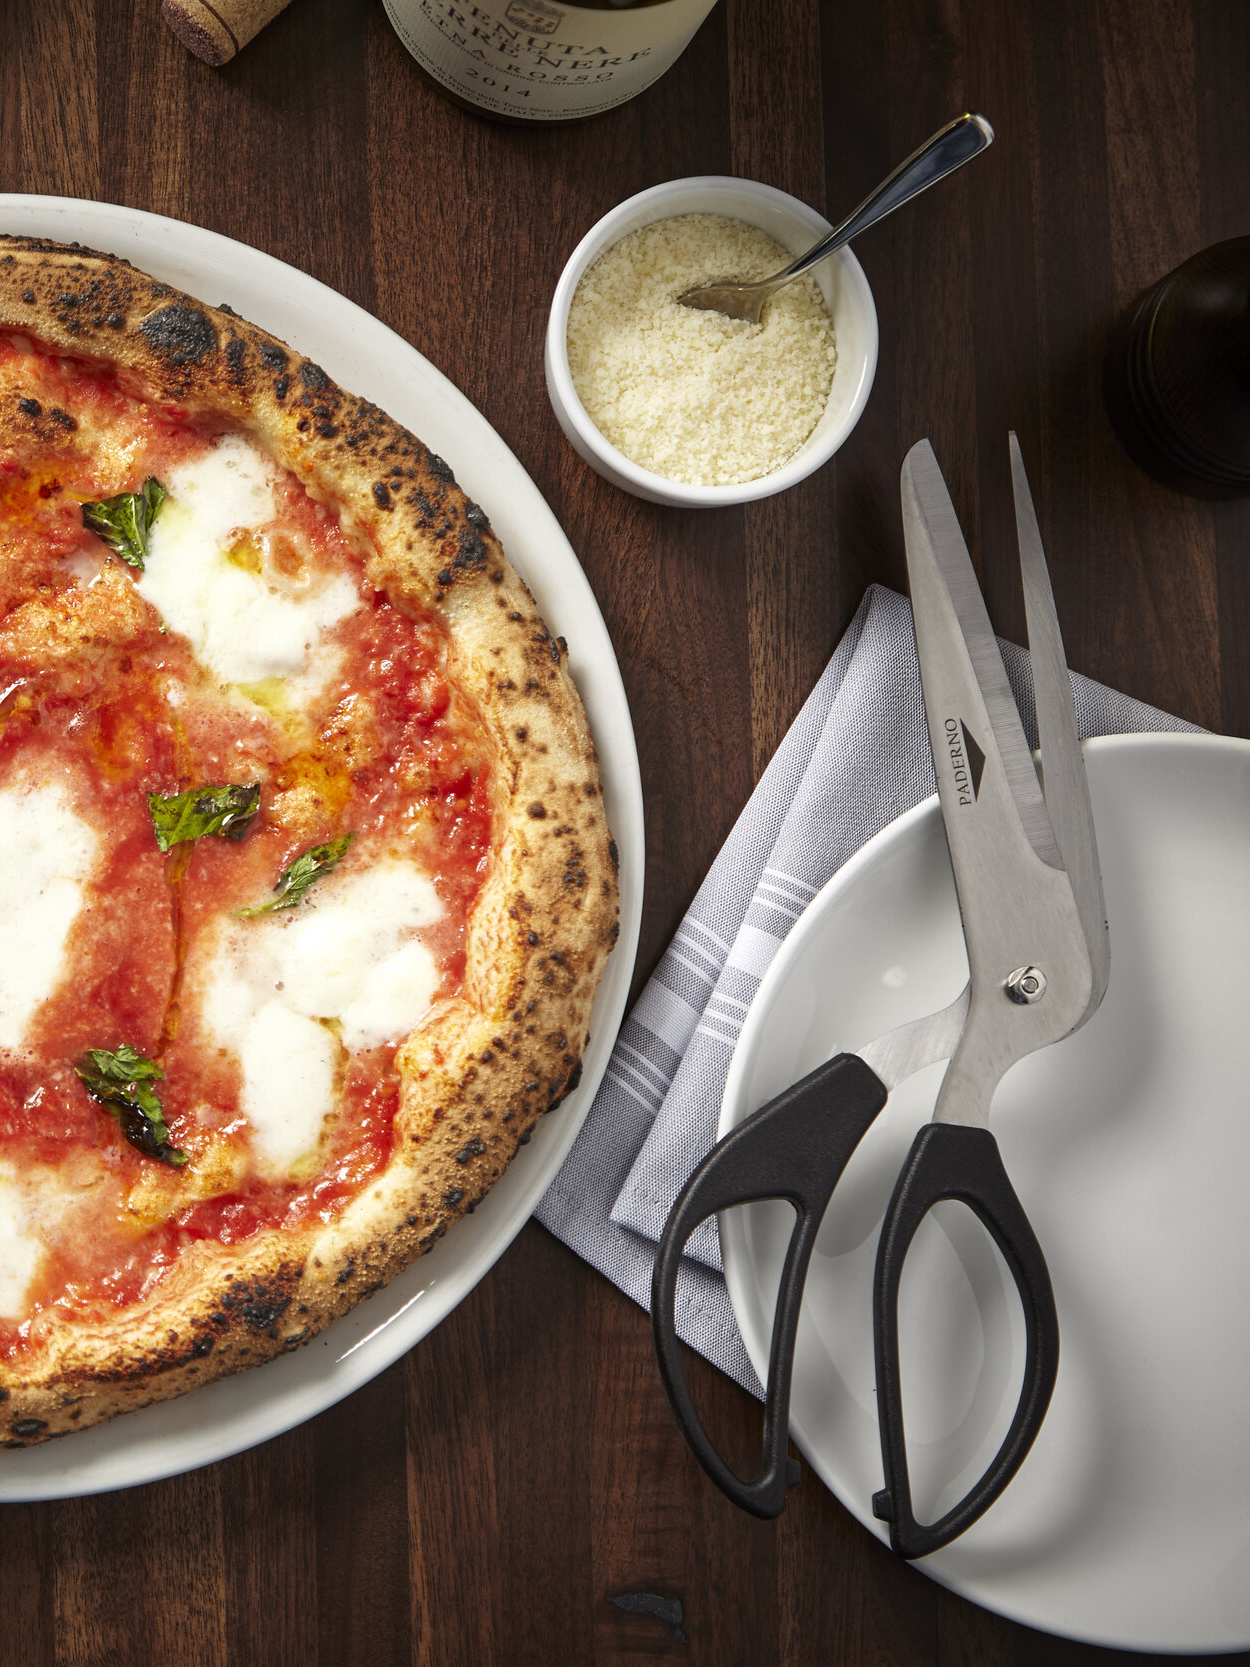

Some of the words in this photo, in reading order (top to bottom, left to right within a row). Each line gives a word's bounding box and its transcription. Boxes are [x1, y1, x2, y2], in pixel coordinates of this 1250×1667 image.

[420, 0, 486, 59] ETNA
[507, 63, 614, 82] ROSSO
[454, 0, 611, 56] ENUTA
[534, 46, 653, 71] NERE
[465, 67, 531, 97] 2014
[502, 105, 536, 117] ITALY
[944, 718, 972, 806] PADERNO
